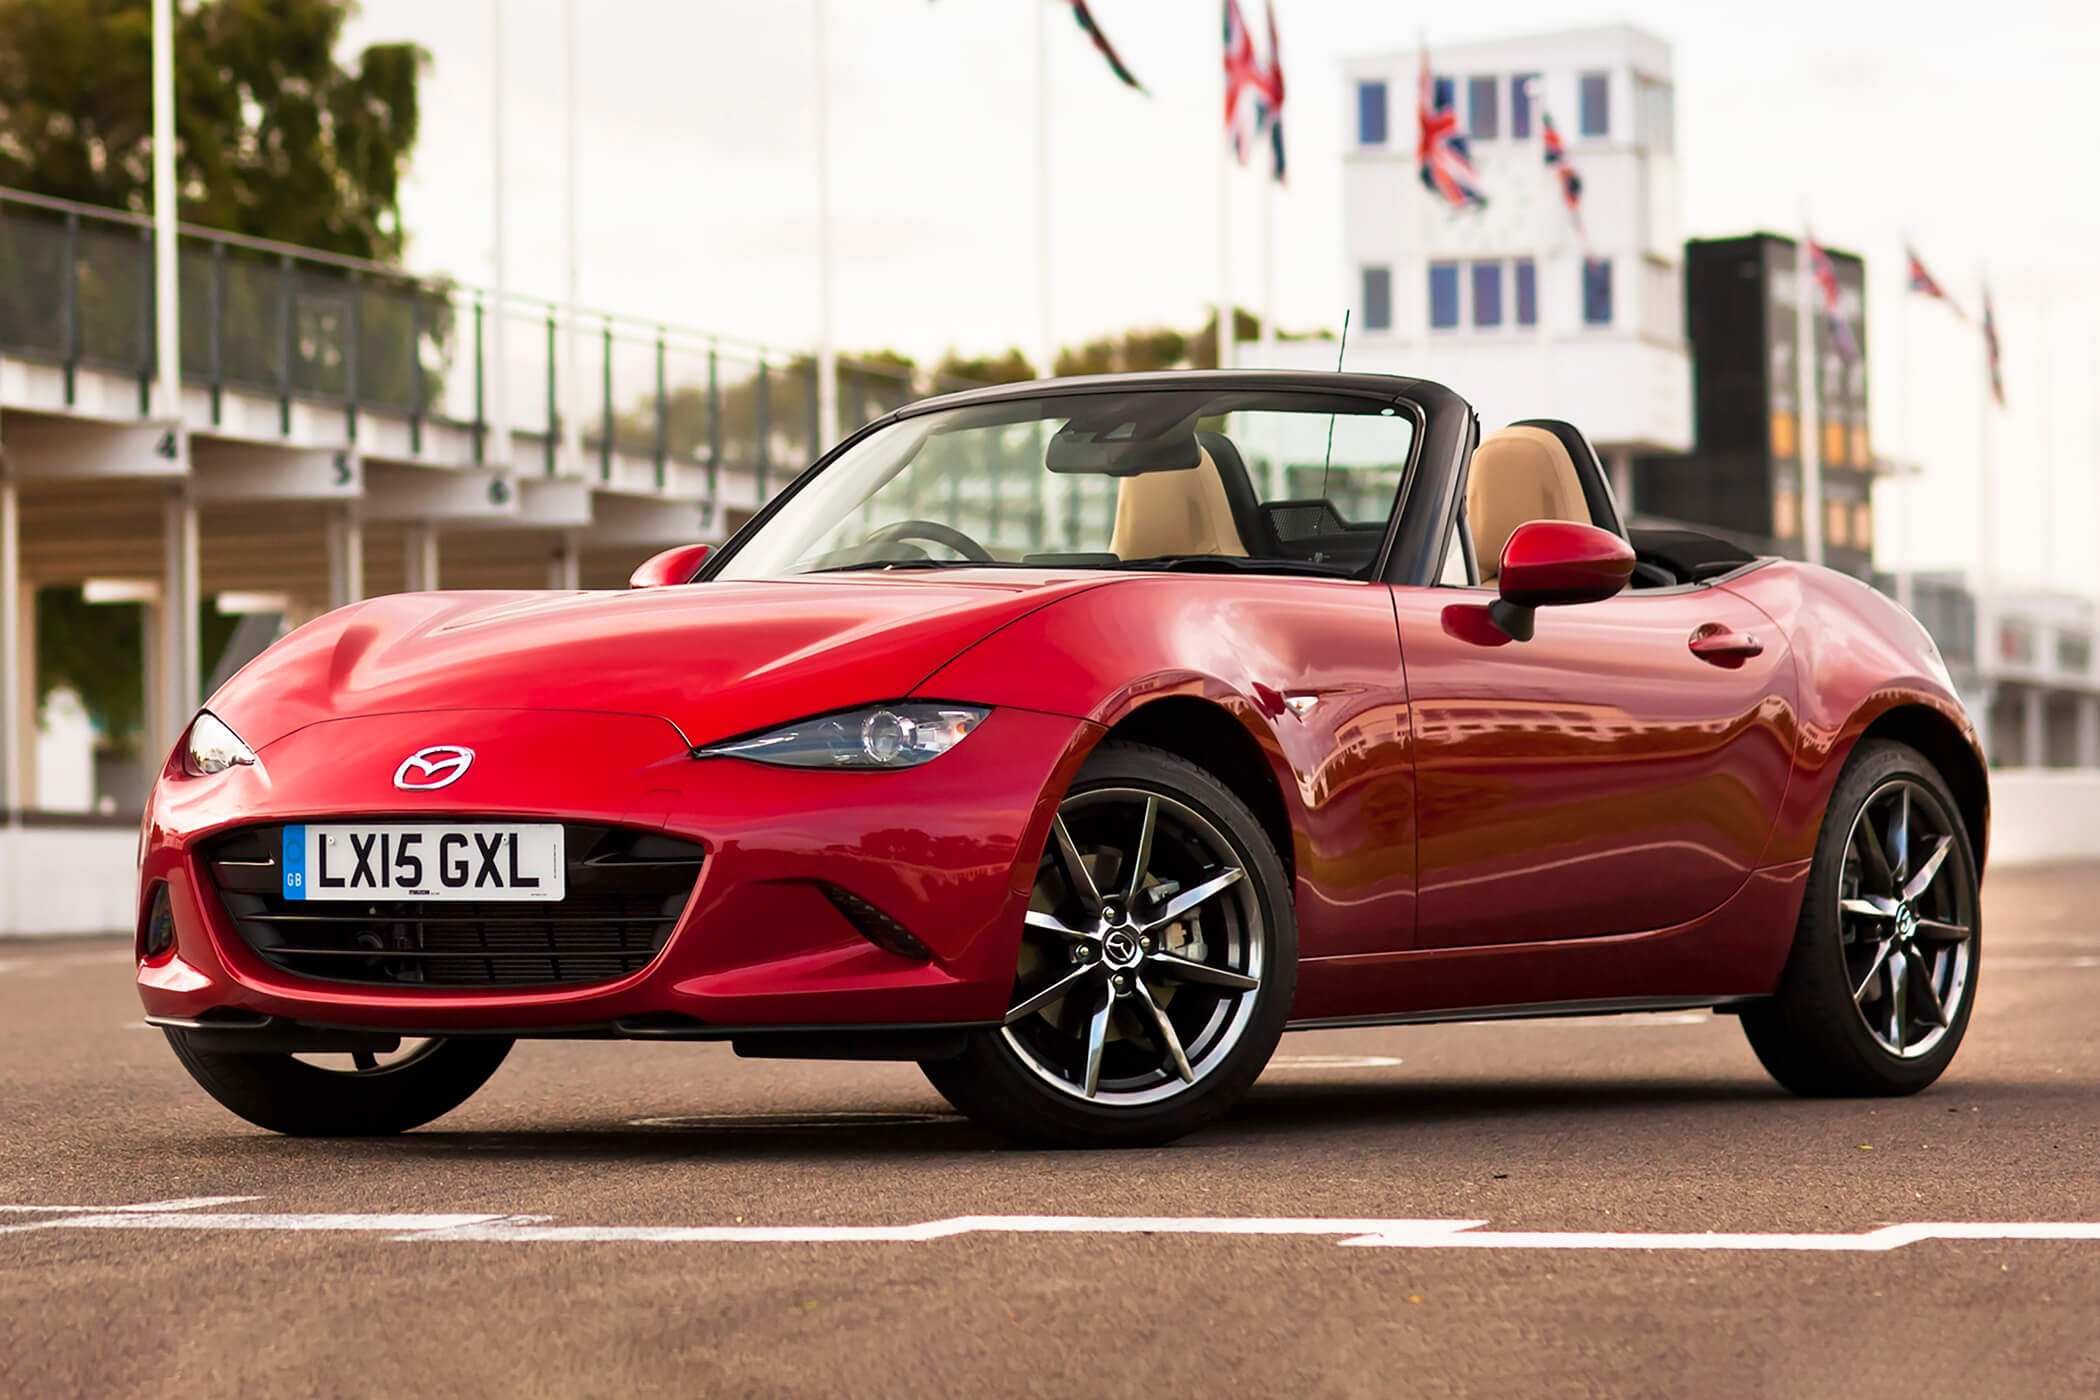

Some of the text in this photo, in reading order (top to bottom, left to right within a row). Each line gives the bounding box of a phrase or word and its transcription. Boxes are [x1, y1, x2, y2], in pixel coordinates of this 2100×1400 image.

[155, 432, 177, 461] 4
[319, 833, 423, 888] LX15
[439, 832, 540, 888] GXL
[287, 873, 302, 887] GB
